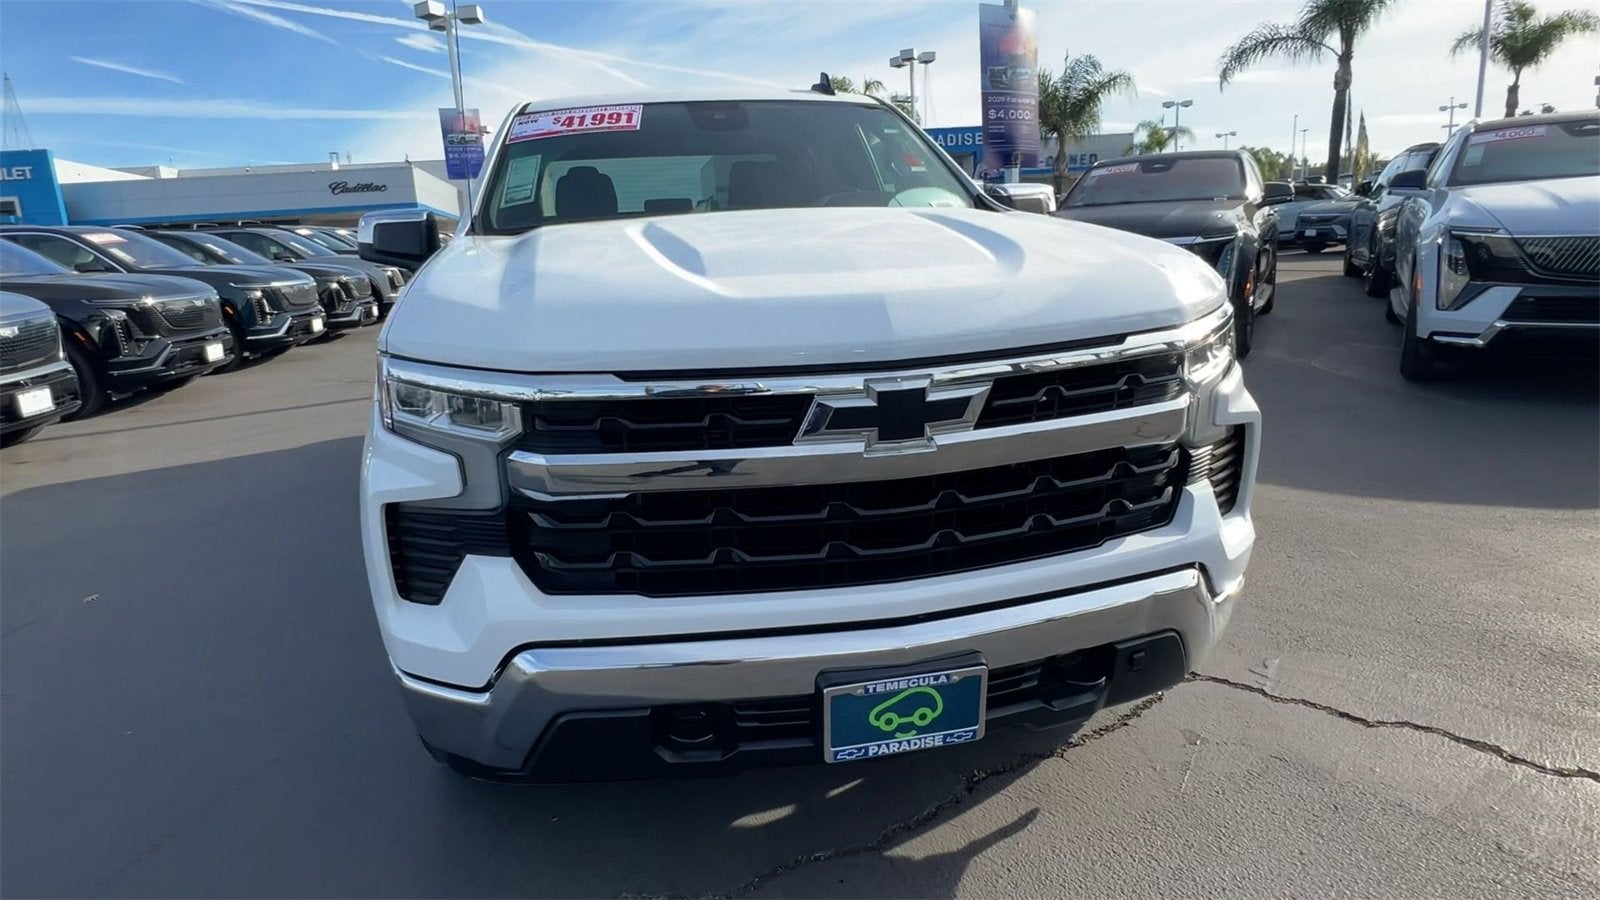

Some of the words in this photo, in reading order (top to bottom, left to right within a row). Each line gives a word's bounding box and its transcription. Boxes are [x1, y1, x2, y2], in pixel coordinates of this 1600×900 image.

[988, 109, 1030, 120] $4,000
[932, 132, 984, 146] ADISE
[0, 166, 33, 180] LET
[328, 181, 388, 196] Cadillac
[867, 675, 947, 692] TEMECULA
[869, 735, 943, 755] PARADISE
